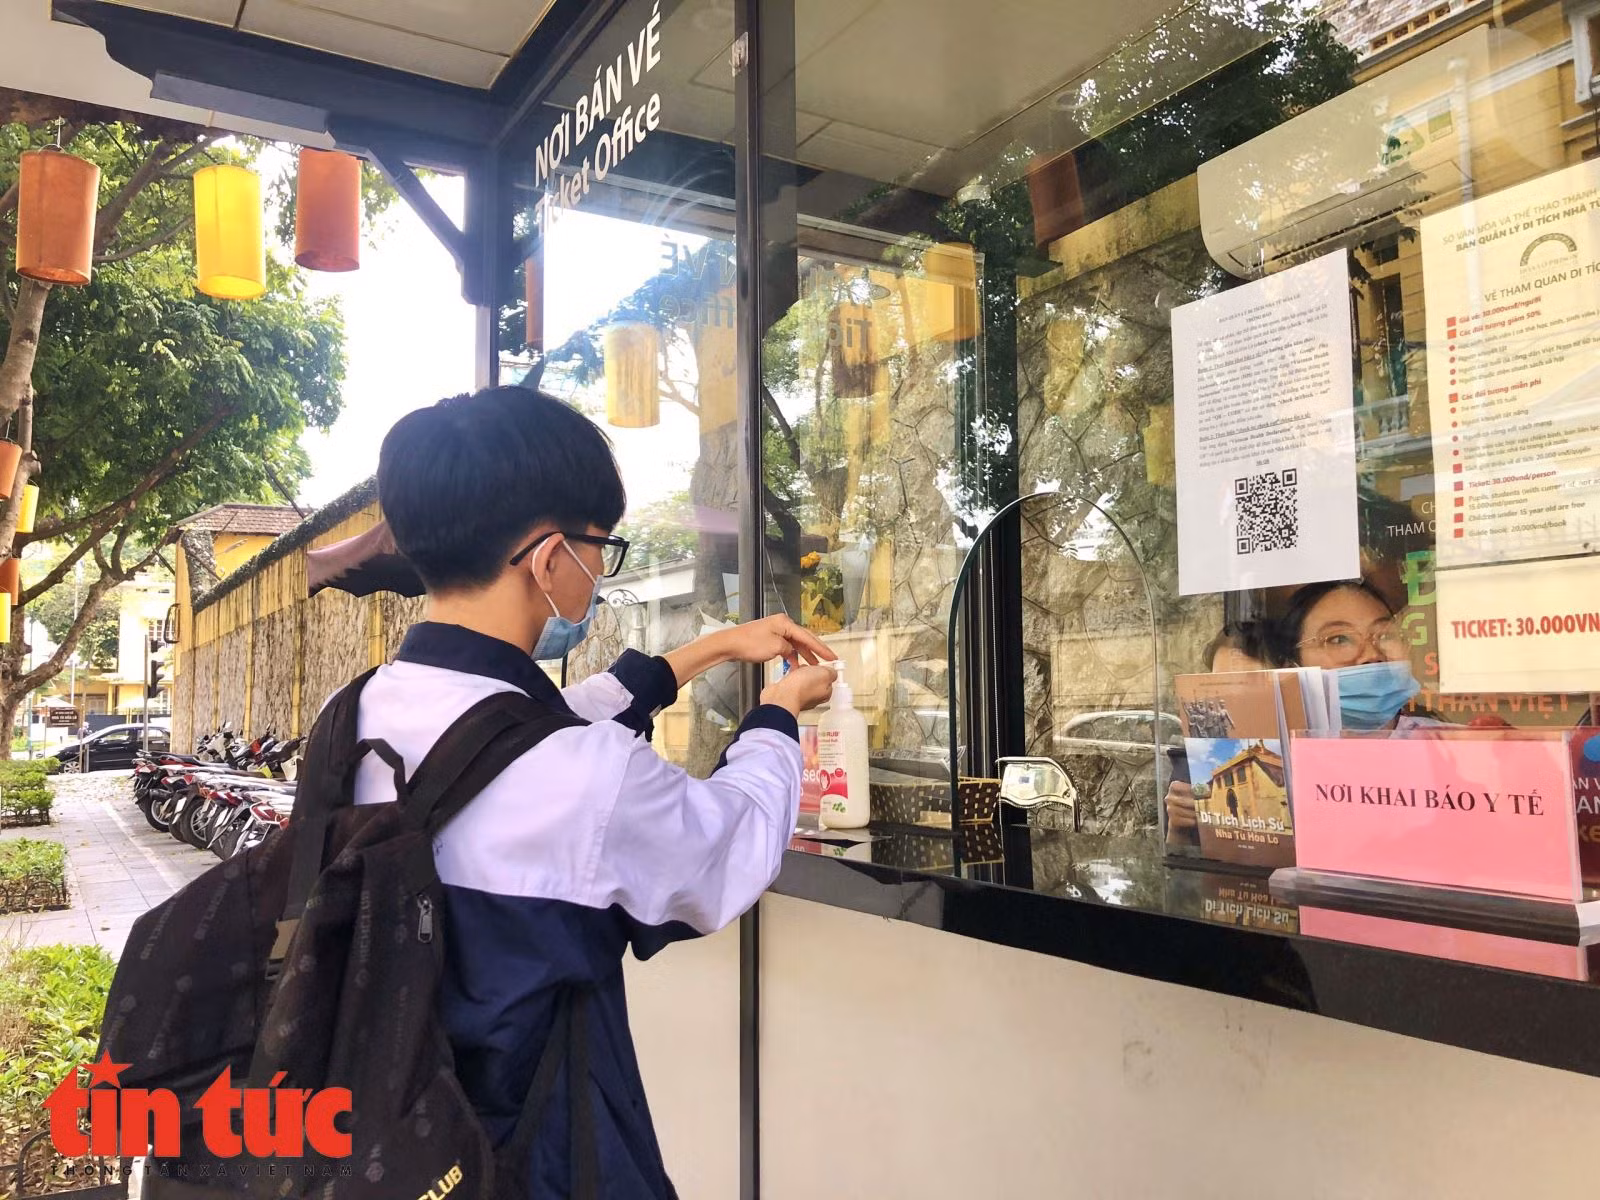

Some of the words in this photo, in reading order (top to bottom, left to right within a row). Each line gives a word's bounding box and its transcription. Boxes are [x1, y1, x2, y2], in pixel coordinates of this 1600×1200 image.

[535, 113, 570, 188] NƠI
[575, 64, 623, 146] BÁN
[627, 0, 662, 87] VÉ
[594, 93, 662, 181] Office
[1456, 240, 1476, 252] BAN
[1523, 220, 1534, 231] DI
[1536, 208, 1560, 225] TÍCH
[1499, 281, 1531, 298] THAM
[1534, 271, 1567, 289] QUAN
[1570, 268, 1582, 279] DI
[1526, 310, 1542, 320] 50%
[1421, 501, 1436, 514] CH
[1529, 507, 1545, 517] year
[1545, 505, 1557, 513] old
[1570, 501, 1586, 509] free
[1387, 521, 1425, 538] THAM
[1451, 618, 1512, 639] TICKET:
[1315, 783, 1353, 804] NƠI
[1360, 786, 1417, 807] KHAI
[1424, 784, 1476, 812] BÁO
[1482, 792, 1500, 813] Y
[1507, 788, 1545, 816] TẾ
